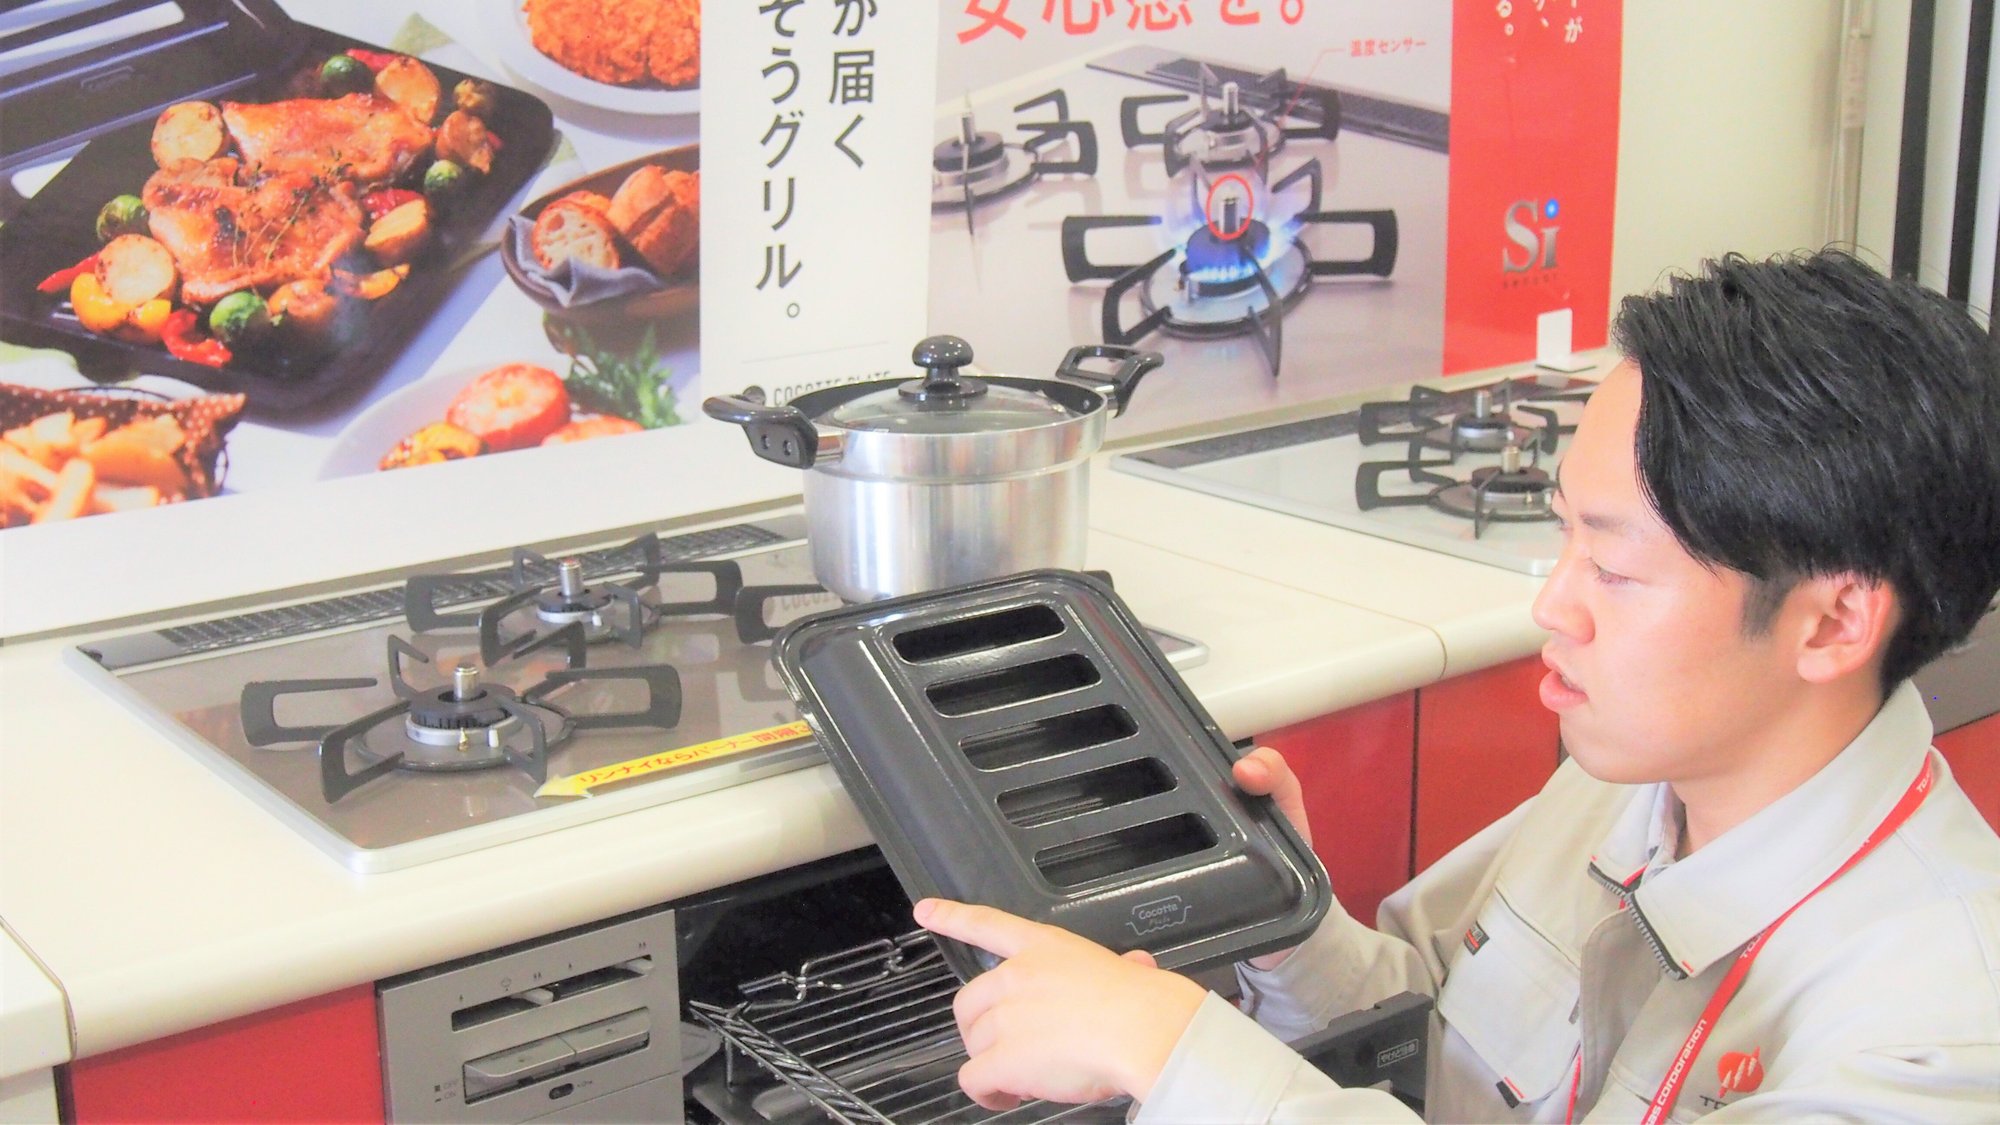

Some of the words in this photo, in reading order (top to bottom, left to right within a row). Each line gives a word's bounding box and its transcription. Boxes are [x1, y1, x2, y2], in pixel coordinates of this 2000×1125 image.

[1502, 197, 1561, 275] Si
[1138, 902, 1179, 920] Cocotte
[1658, 1018, 1707, 1106] corporation
